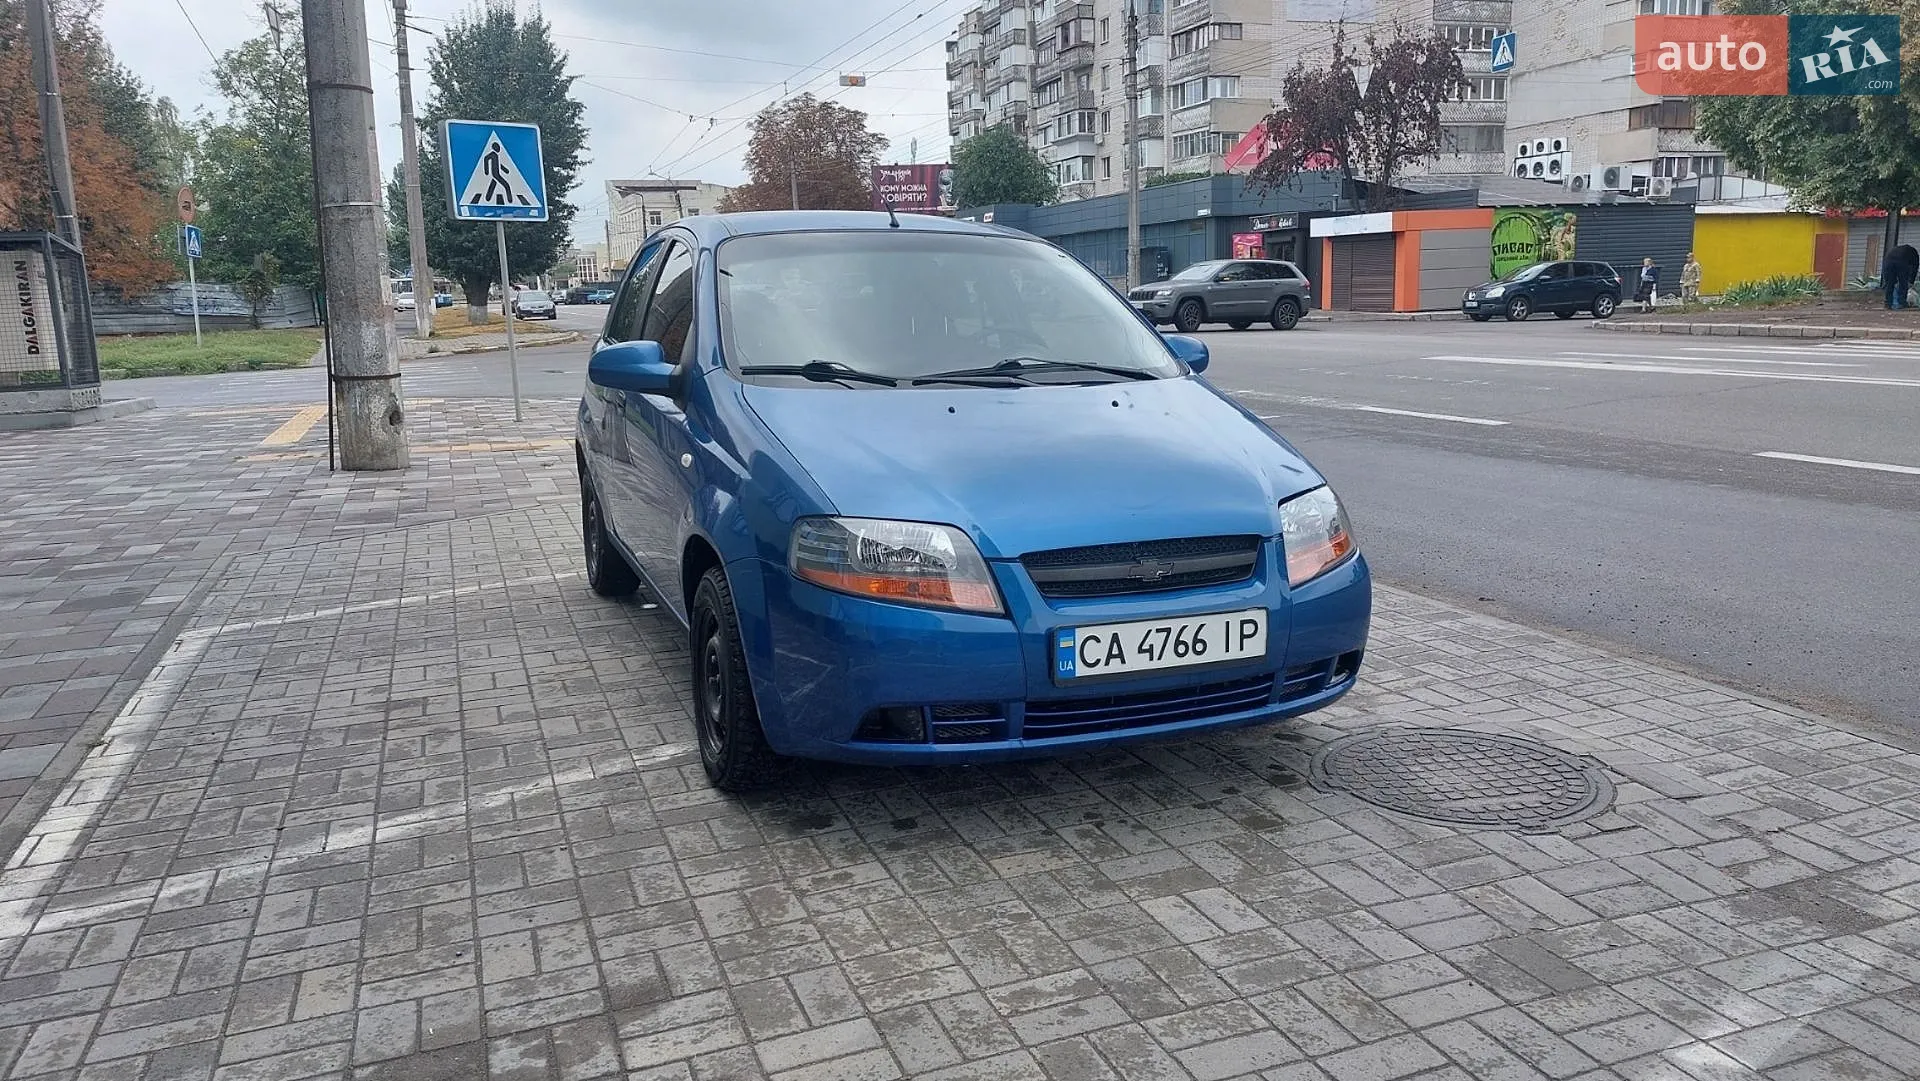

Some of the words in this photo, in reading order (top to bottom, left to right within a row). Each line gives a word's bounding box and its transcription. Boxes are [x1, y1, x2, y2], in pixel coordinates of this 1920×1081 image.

[901, 184, 928, 192] МОЖНА
[14, 260, 40, 355] DALGAKIRAN
[1079, 632, 1126, 668] CA
[1137, 623, 1207, 662] 4766
[1225, 618, 1259, 653] IP
[1059, 660, 1074, 671] UA
